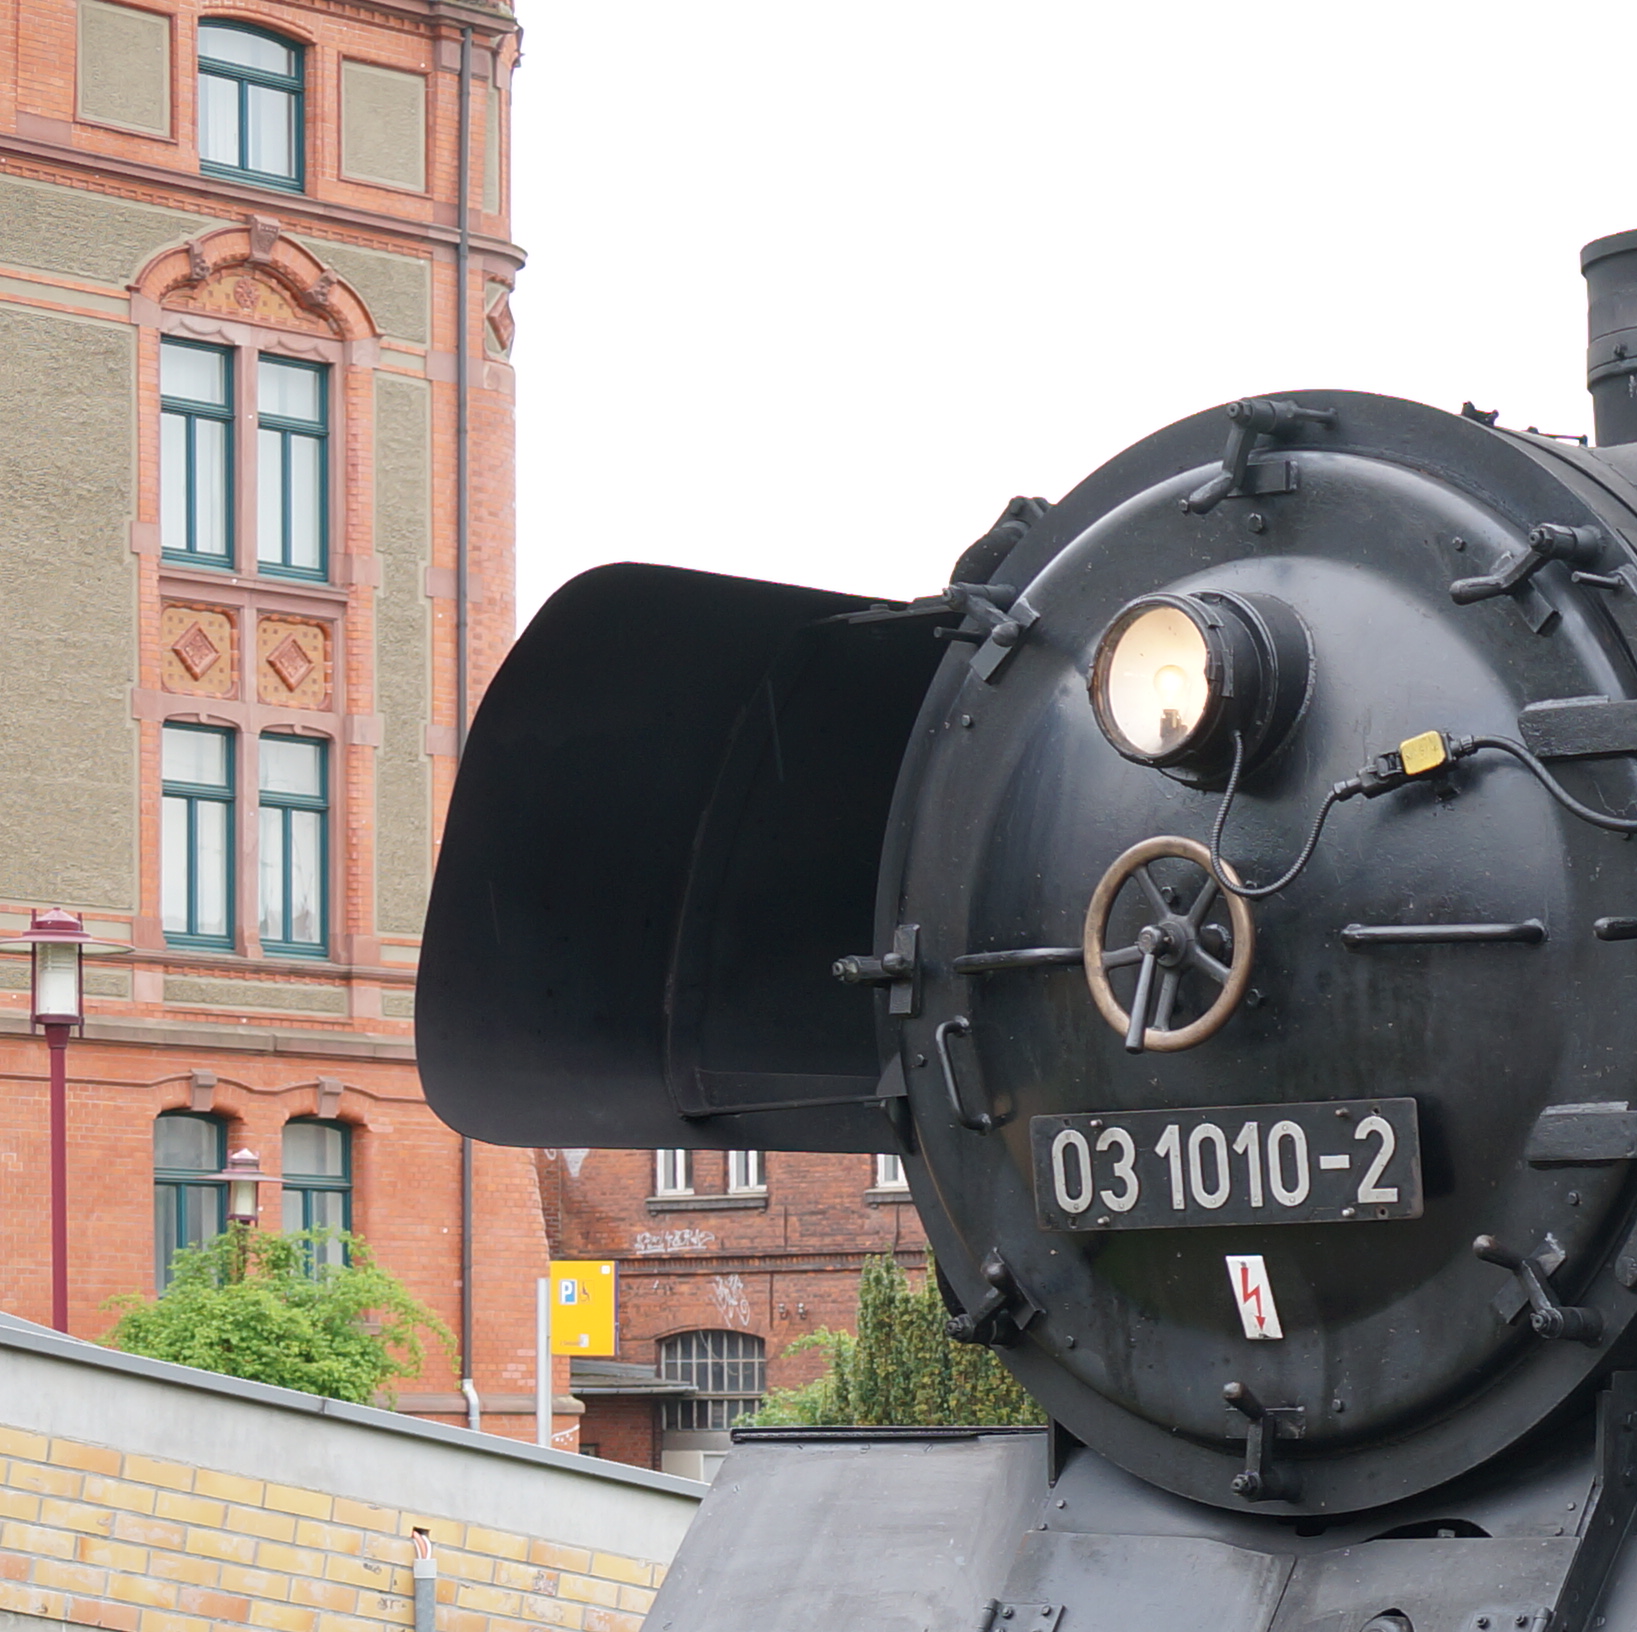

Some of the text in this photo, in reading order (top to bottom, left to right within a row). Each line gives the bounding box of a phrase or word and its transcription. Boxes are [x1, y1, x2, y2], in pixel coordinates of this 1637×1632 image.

[1052, 1115, 1398, 1213] 03 1010-2
[561, 1281, 573, 1303] P
